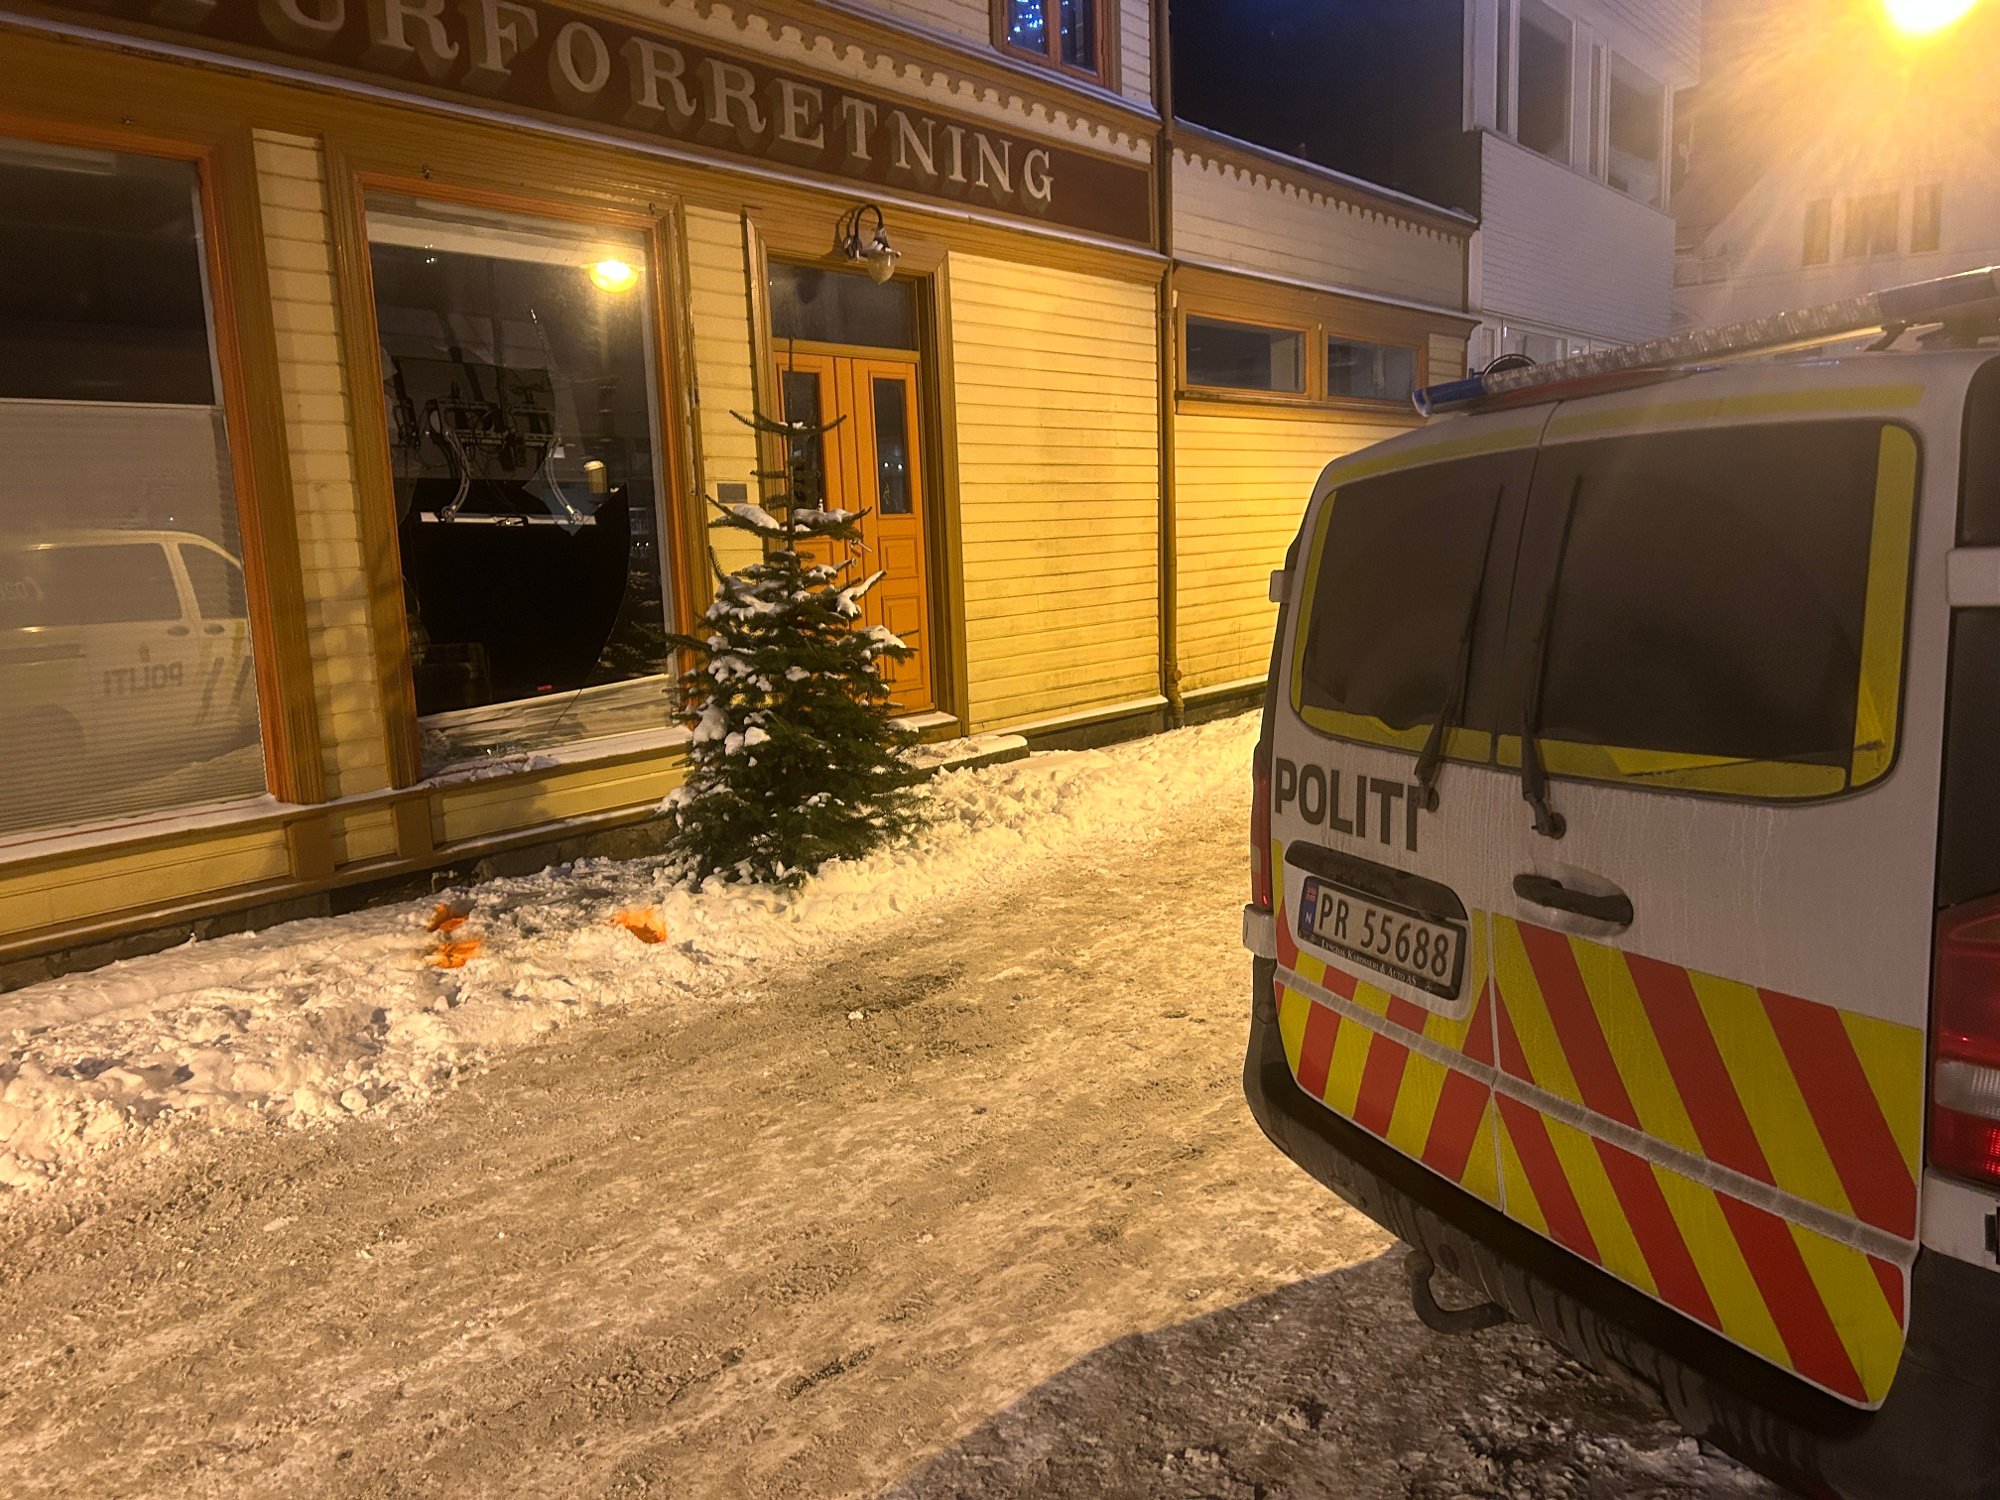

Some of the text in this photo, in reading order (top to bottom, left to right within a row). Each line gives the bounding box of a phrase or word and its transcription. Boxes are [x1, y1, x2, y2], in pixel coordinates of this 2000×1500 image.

[197, 0, 1055, 202] RFORRETNING
[1274, 757, 1420, 852] POLITI
[1305, 911, 1312, 923] N
[1319, 893, 1449, 977] PR 55688
